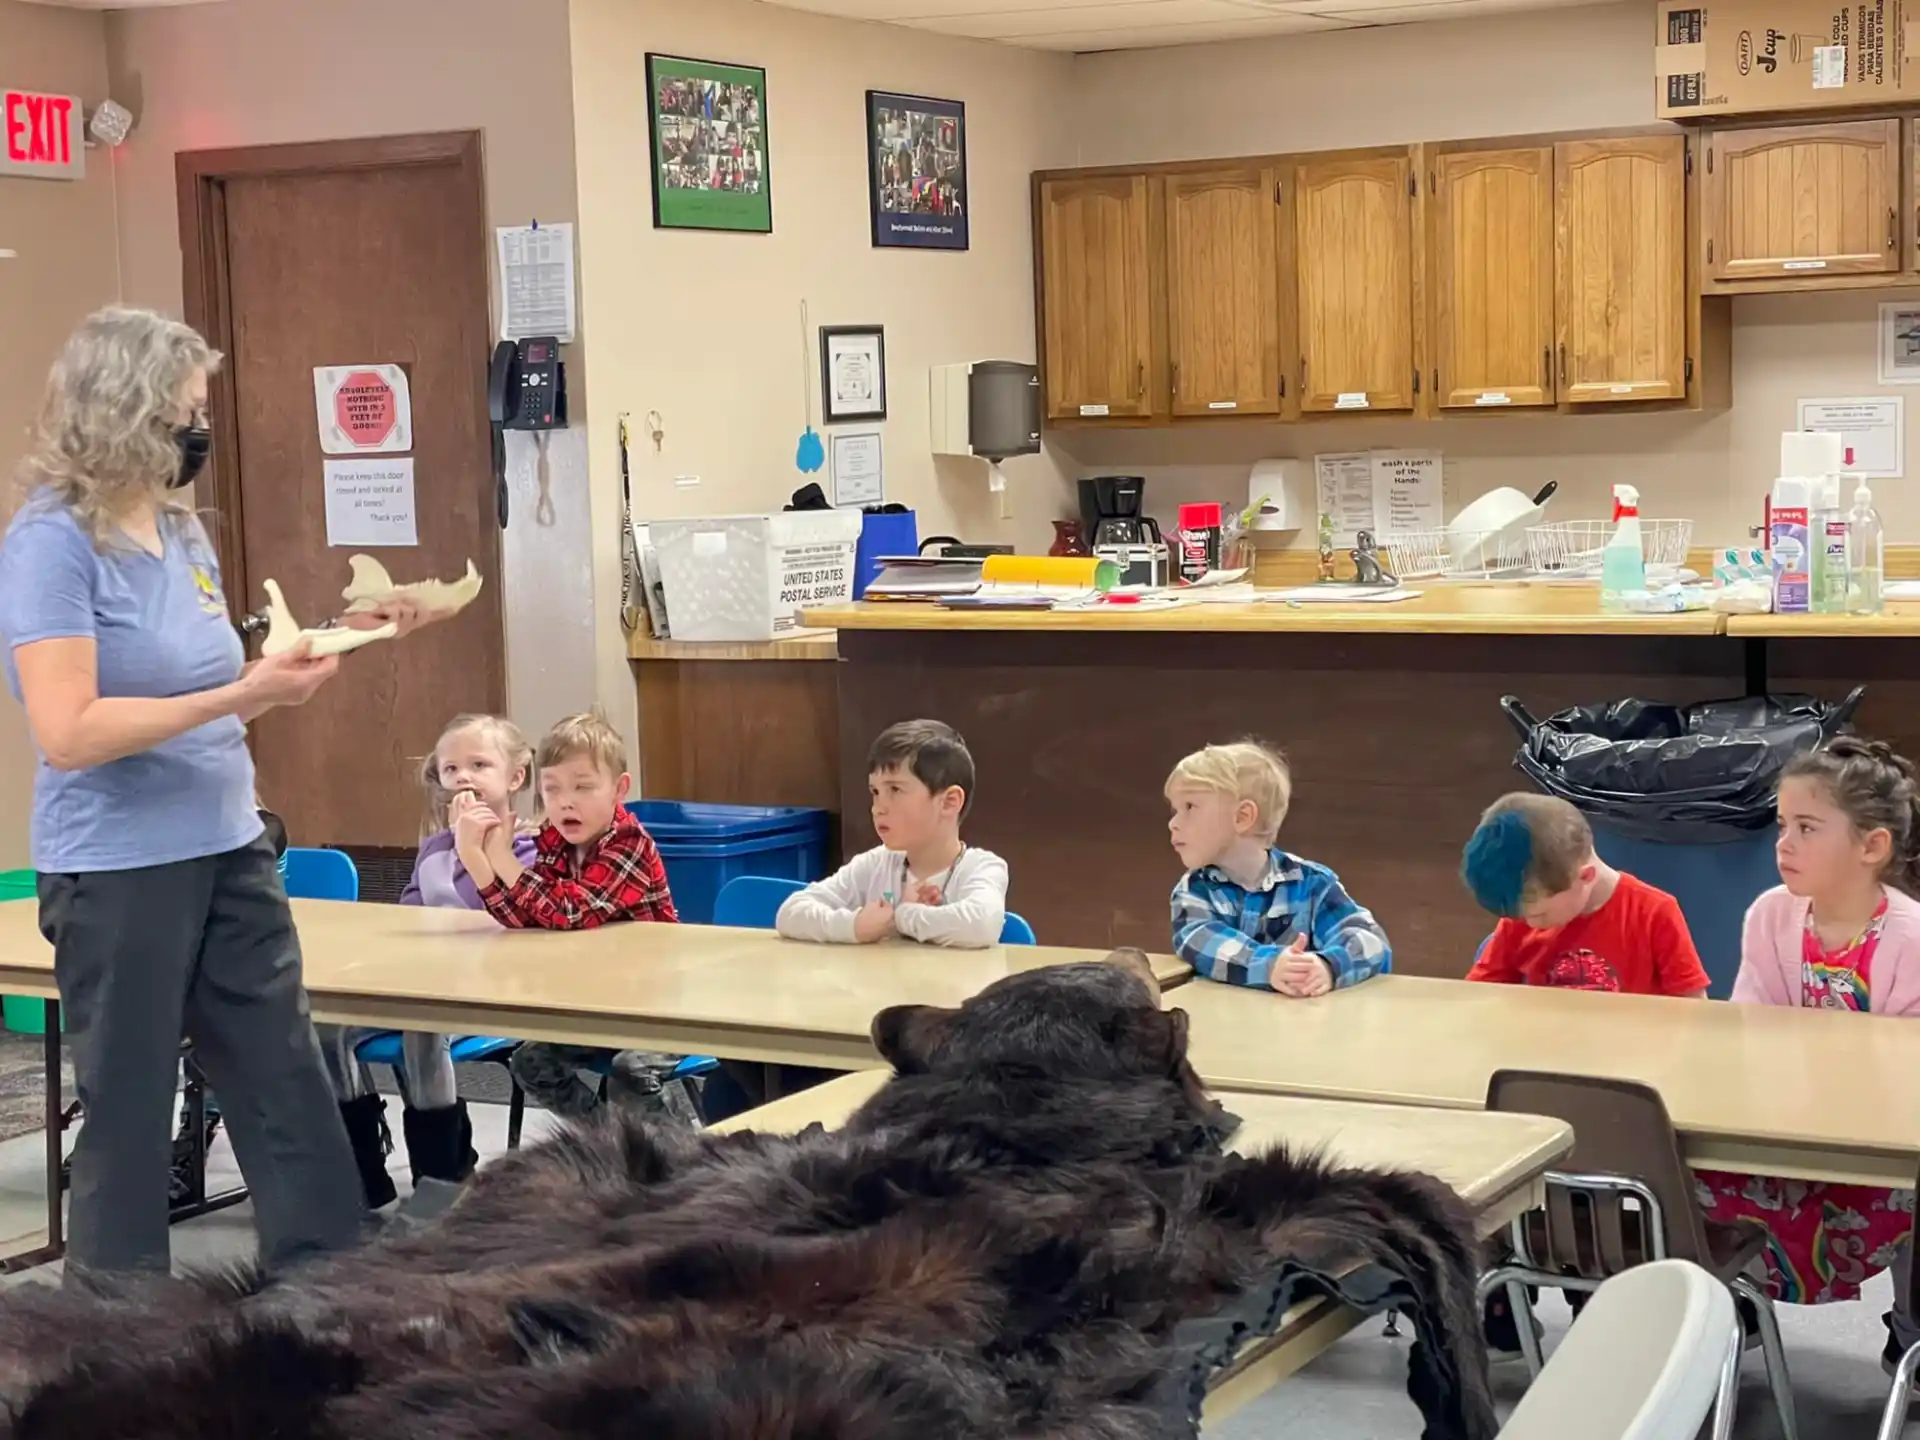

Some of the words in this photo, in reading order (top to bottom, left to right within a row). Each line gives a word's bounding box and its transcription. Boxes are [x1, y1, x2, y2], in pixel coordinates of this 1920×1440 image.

[1832, 15, 1840, 40] COLD
[1841, 7, 1849, 32] CUPS
[1867, 10, 1875, 50] BEBIDAS
[1858, 53, 1866, 82] VASOS
[1867, 51, 1875, 75] PARA
[1875, 36, 1883, 85] CALIENTES
[5, 92, 72, 165] EXIT
[784, 571, 813, 586] UNITED
[815, 567, 843, 583] STATES
[780, 588, 812, 602] POSTAL
[813, 584, 846, 599] SERVICE
